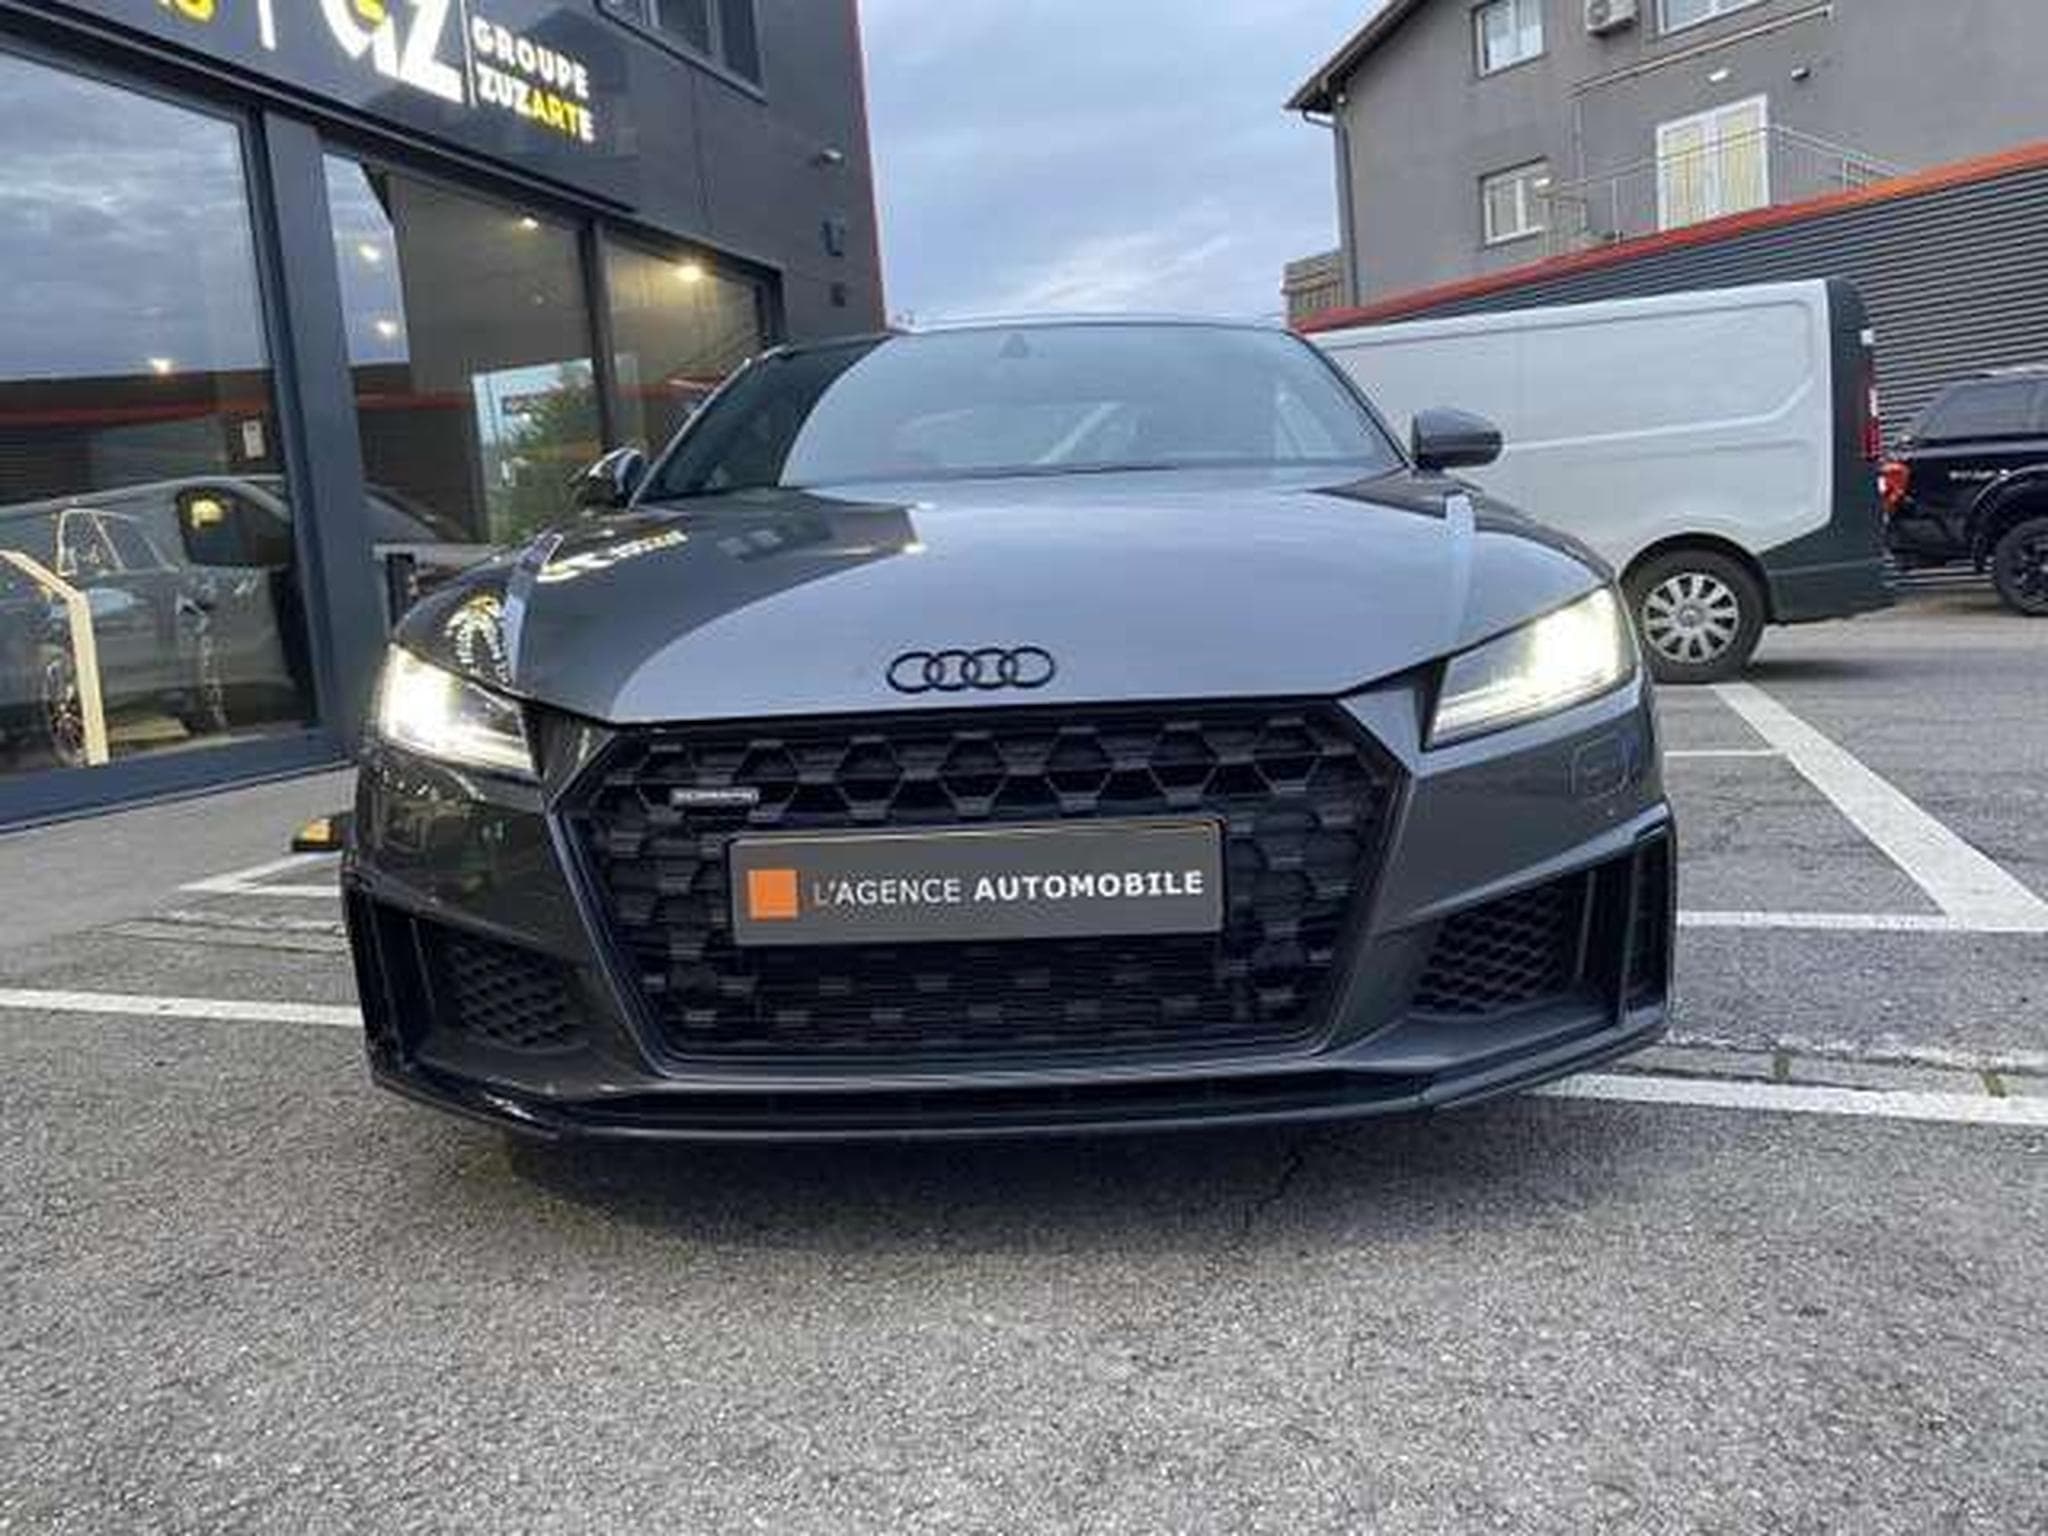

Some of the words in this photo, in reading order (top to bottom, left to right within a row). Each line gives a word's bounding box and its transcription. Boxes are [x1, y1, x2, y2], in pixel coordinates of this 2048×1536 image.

[472, 16, 589, 99] GROUPE
[476, 62, 594, 141] ZUZARTE
[813, 879, 961, 905] L'AGENCE
[974, 870, 1204, 902] AUTOMOBILE
